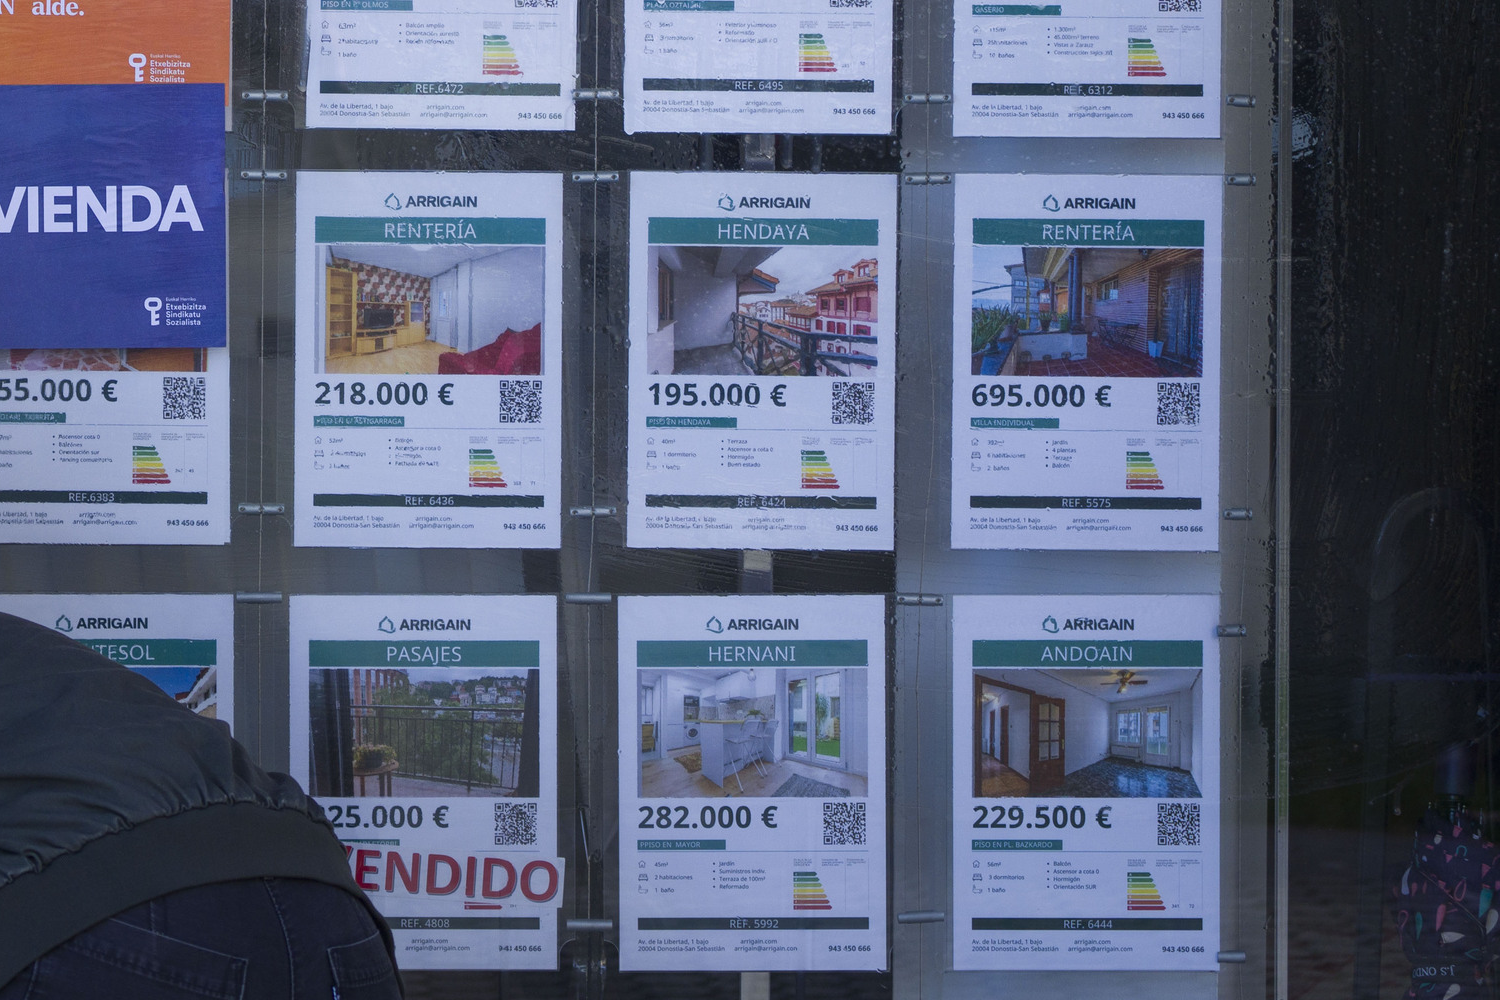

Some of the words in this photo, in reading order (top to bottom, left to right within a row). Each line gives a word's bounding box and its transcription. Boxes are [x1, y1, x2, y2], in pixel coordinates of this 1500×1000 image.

[406, 196, 477, 208] ARRIGAIN
[385, 219, 476, 239] RENTERÍA
[719, 224, 809, 239] HENDAYA
[1043, 221, 1134, 240] RENTERÍA
[102, 380, 117, 402] €
[315, 382, 428, 405] 218.000
[438, 383, 454, 405] €
[649, 383, 760, 407] 195.000
[770, 384, 786, 407] €
[972, 384, 1085, 407] 695.000
[1095, 385, 1111, 407] €
[1062, 498, 1082, 507] REF.
[1087, 499, 1111, 507] 5575
[728, 619, 798, 630] ARRIGAIN
[387, 647, 461, 664] PASAJES
[709, 646, 795, 661] HERNANI
[1041, 646, 1132, 661] ANDOAIN
[639, 806, 751, 828] 282.000
[761, 806, 777, 828] €
[973, 806, 1085, 828] 229.500
[1096, 806, 1111, 828] €
[401, 919, 422, 927] REF.
[425, 919, 449, 927] 4808
[1064, 920, 1084, 928] REF.
[1088, 920, 1112, 928] 6444
